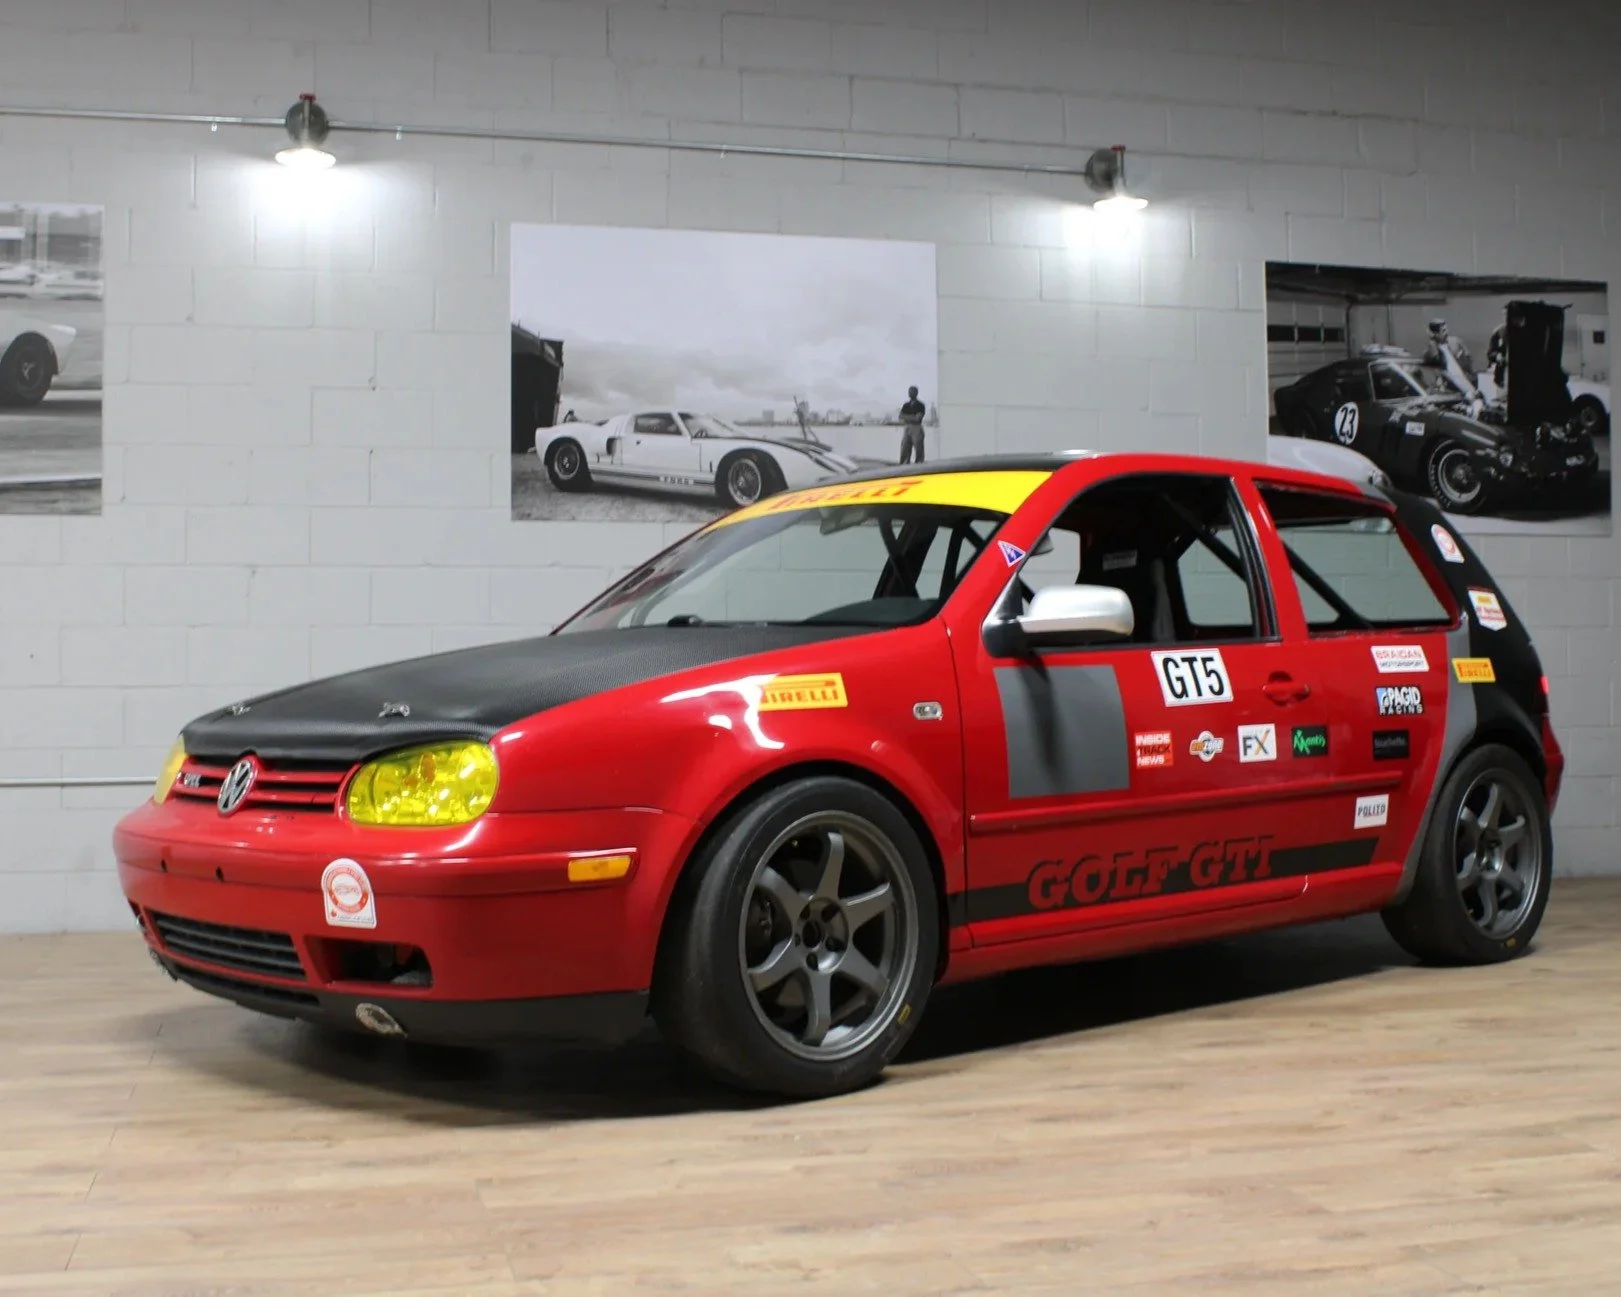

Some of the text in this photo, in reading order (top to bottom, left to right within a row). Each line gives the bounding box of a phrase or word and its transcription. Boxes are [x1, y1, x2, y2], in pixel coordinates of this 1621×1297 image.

[1339, 403, 1357, 443] 23
[1161, 655, 1226, 700] GT5
[1386, 686, 1422, 707] PAGID
[1380, 704, 1424, 715] RACING
[1135, 732, 1171, 746] INSIDE
[1242, 729, 1271, 756] FX
[1137, 743, 1171, 755] TRACK
[1136, 755, 1165, 767] NEWS
[1357, 803, 1387, 818] POLITO
[1027, 834, 1275, 910] GOLF GTI
